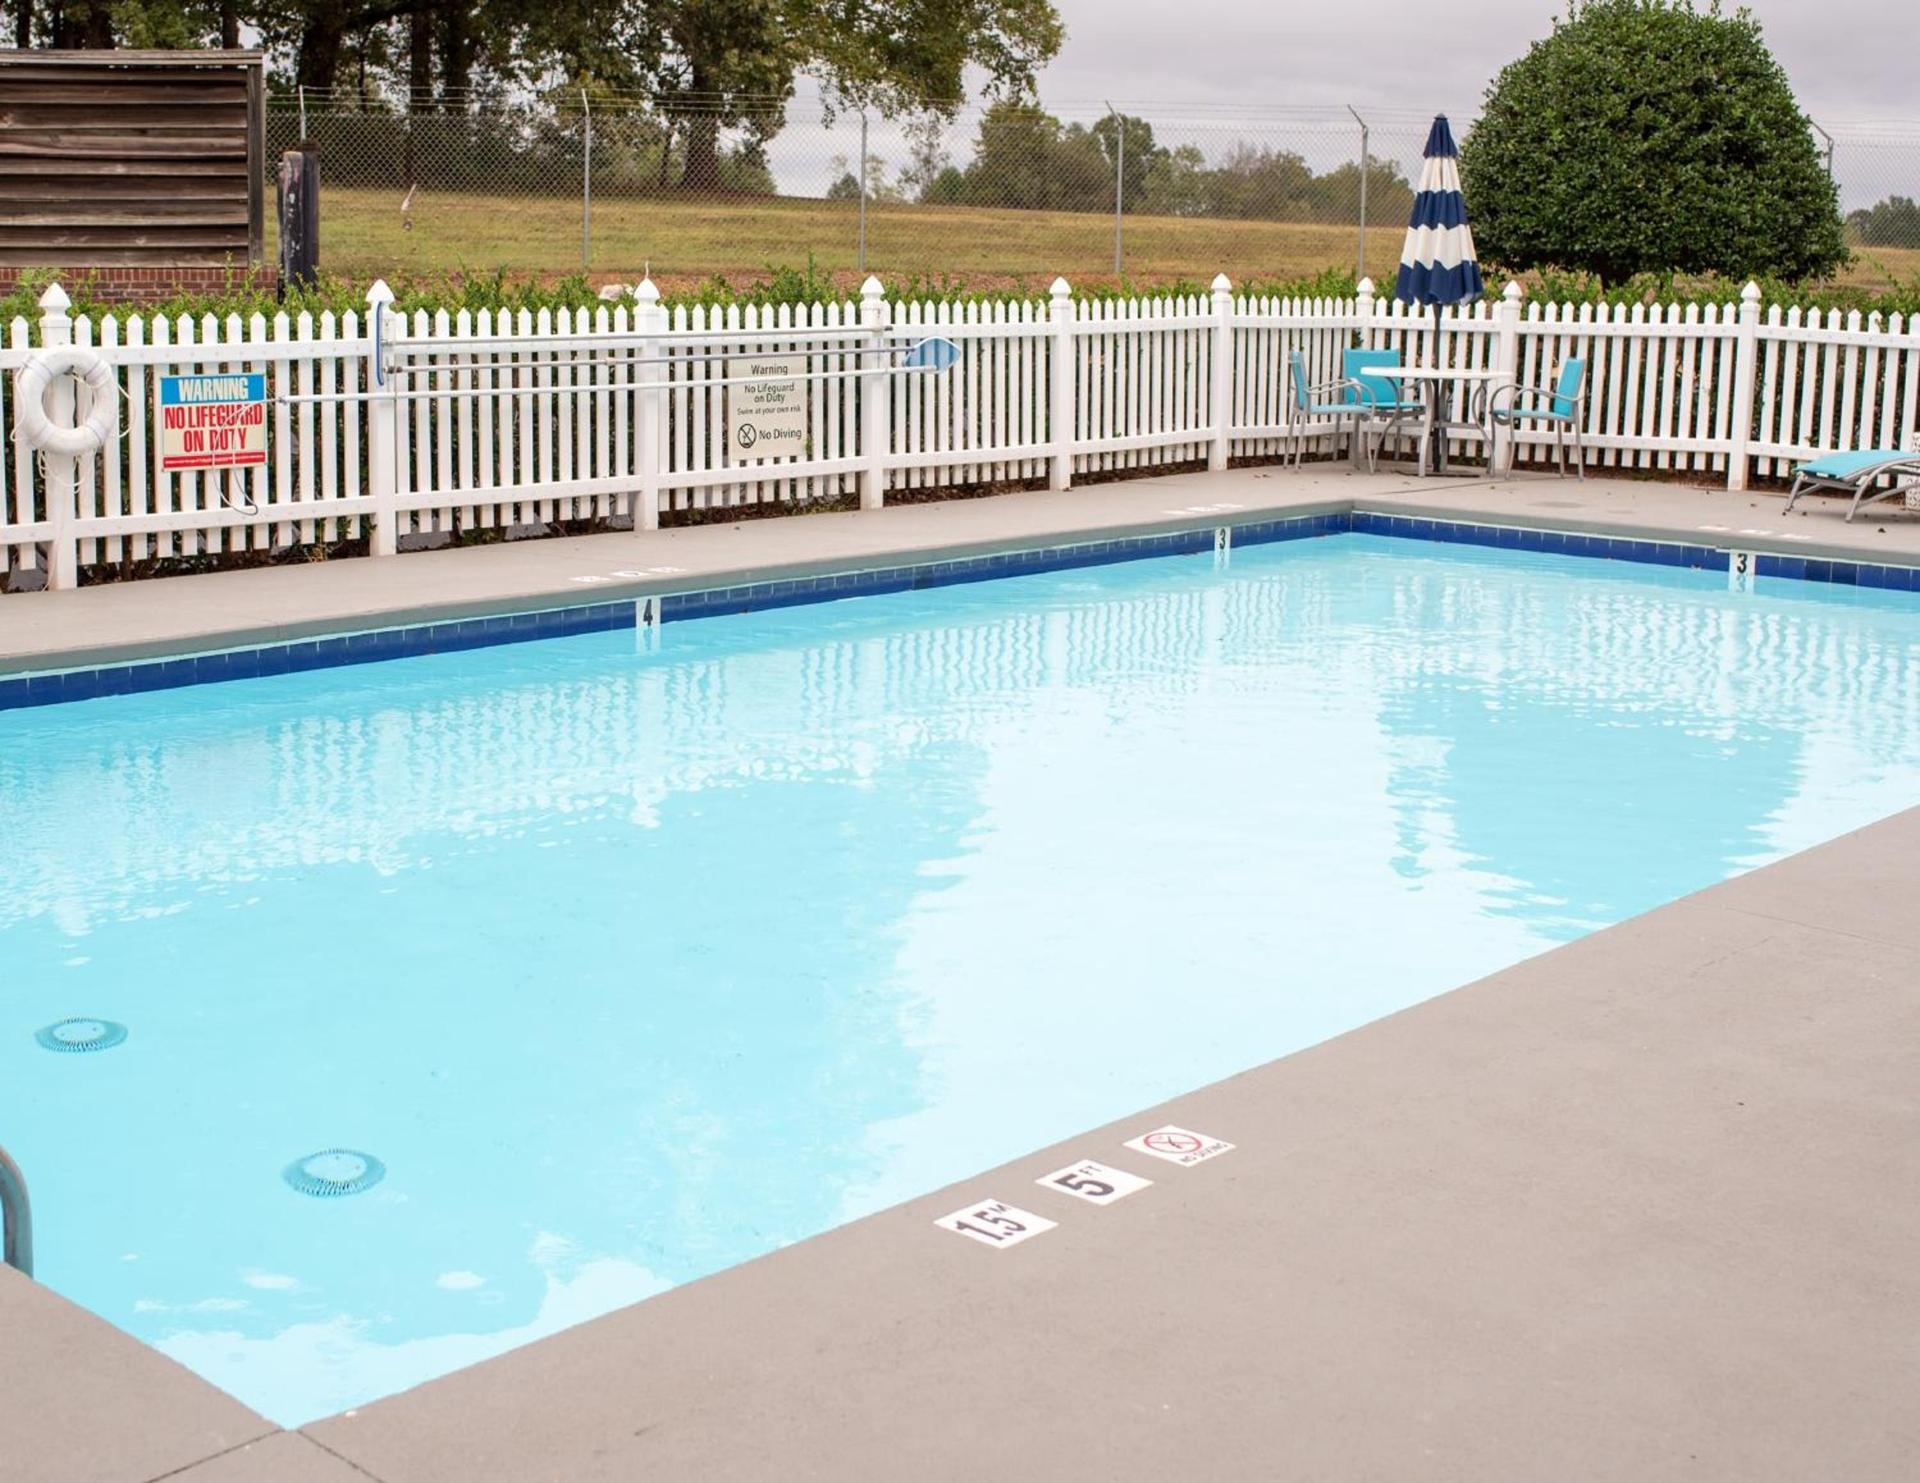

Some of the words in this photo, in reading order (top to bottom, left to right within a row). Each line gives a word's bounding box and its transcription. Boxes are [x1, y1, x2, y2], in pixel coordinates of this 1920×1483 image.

[751, 364, 788, 375] Warning
[178, 377, 249, 402] WARNING
[744, 385, 756, 393] No
[757, 382, 795, 394] Lifeguard
[766, 393, 785, 403] Duty
[165, 406, 185, 430] NO
[188, 403, 263, 428] LIFEGUARD
[762, 407, 775, 415] your
[183, 430, 204, 453] ON
[759, 430, 772, 439] No
[773, 427, 802, 440] Diving
[1219, 528, 1226, 550] 3
[1736, 553, 1748, 573] 3
[643, 598, 653, 627] 4
[1052, 1173, 1115, 1197] 5
